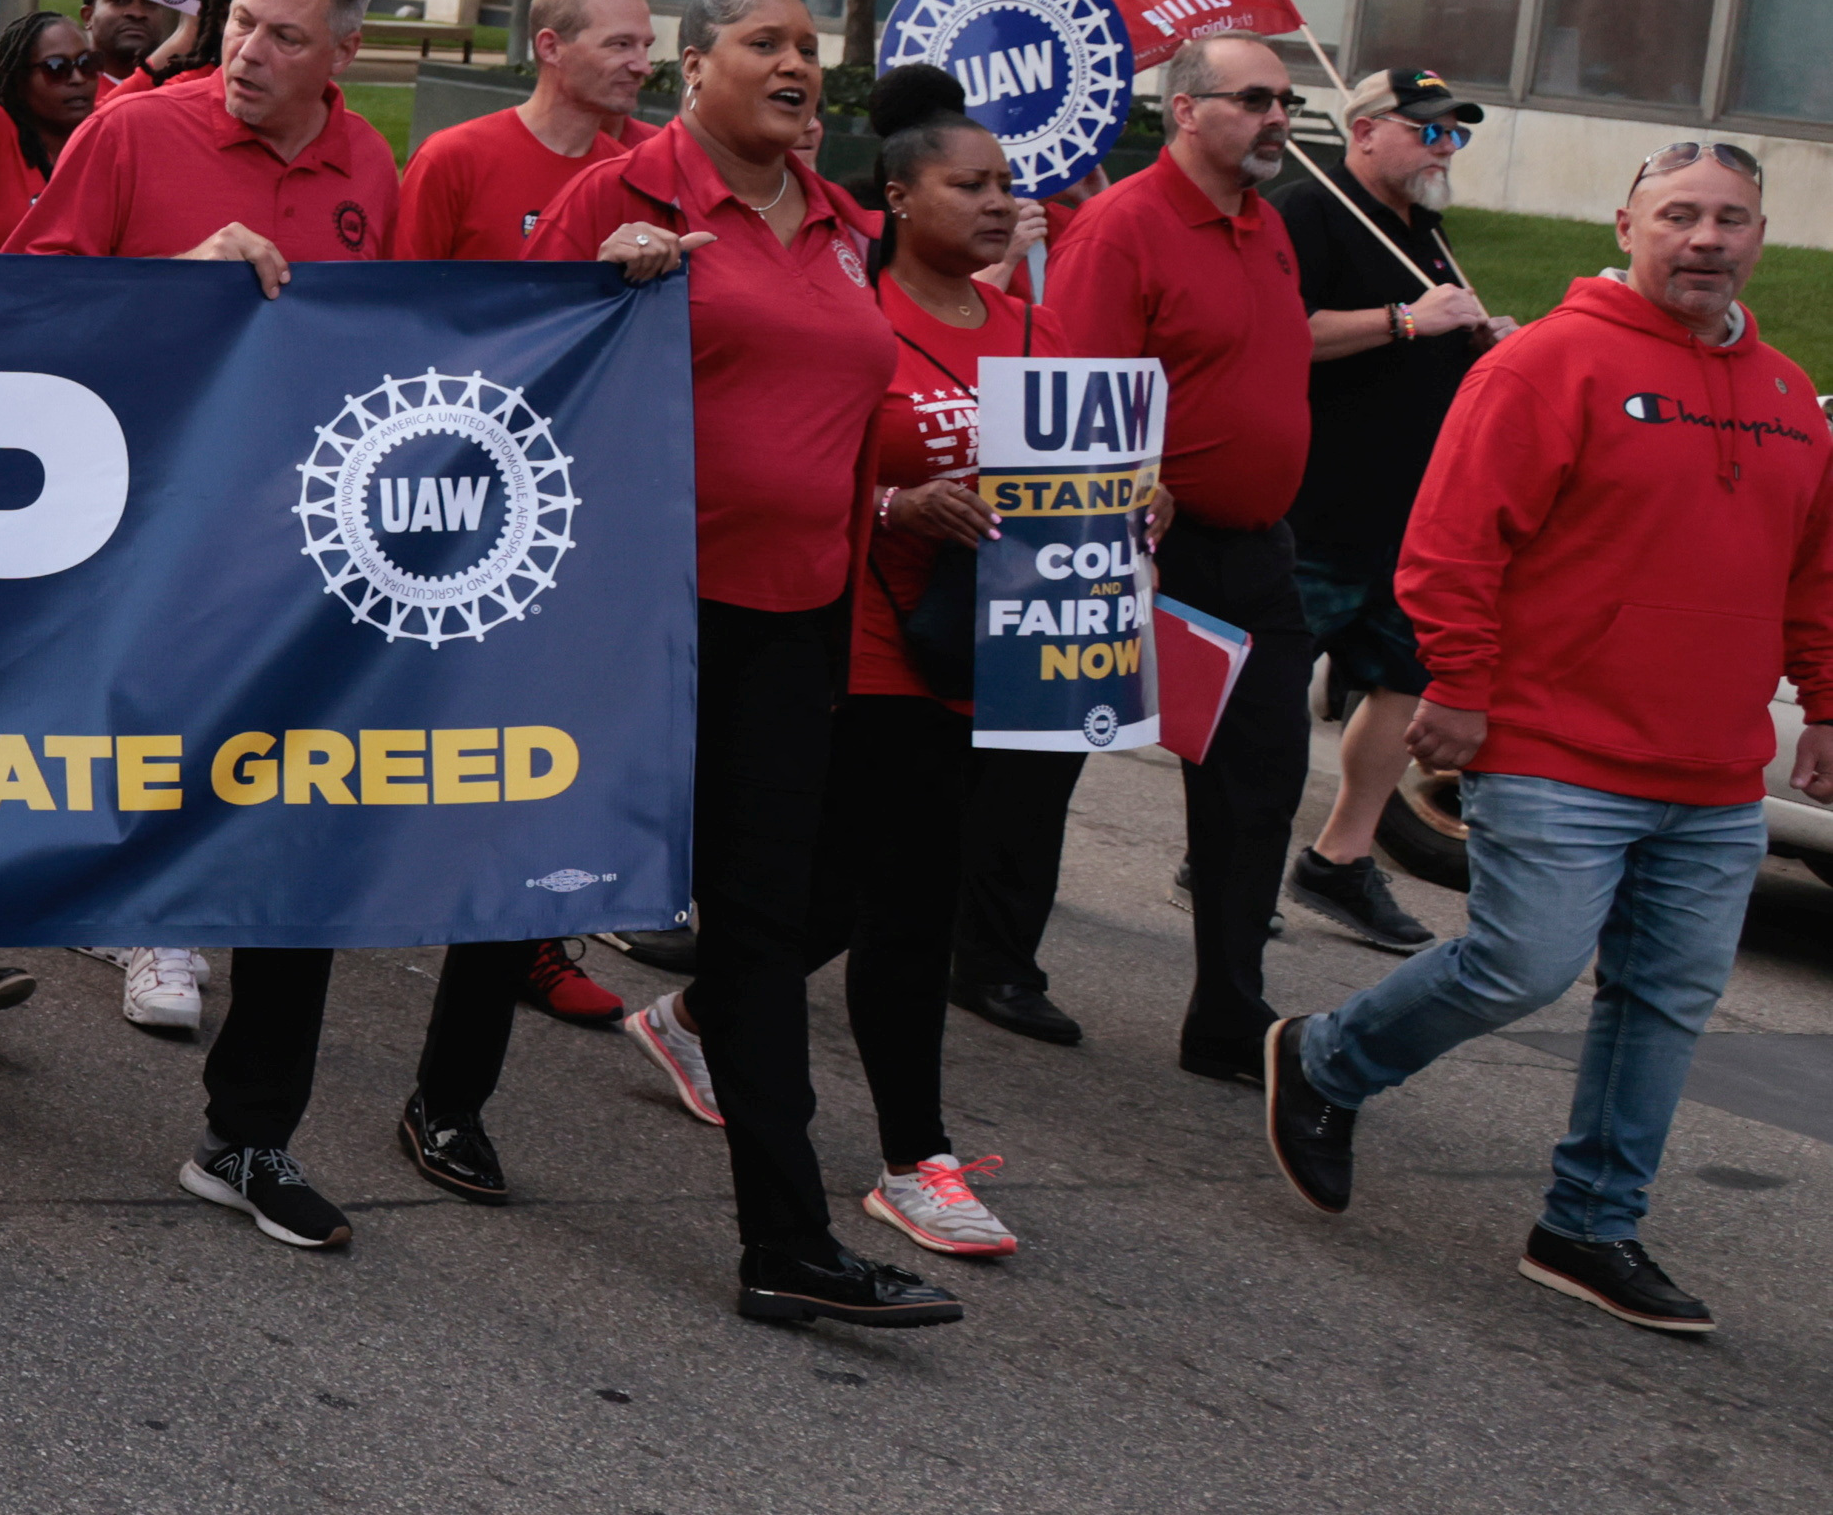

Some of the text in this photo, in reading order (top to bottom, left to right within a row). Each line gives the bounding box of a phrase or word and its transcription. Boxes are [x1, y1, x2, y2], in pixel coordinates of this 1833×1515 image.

[955, 40, 1052, 107] UAW
[1074, 37, 1087, 82] WORKERS
[1056, 101, 1081, 134] AMERICA
[1024, 371, 1155, 452] UAW
[1623, 392, 1813, 447] Champion
[341, 412, 529, 599] UNITED AUTOMOBILE, AEROSPACE AND AGRICULTURAL IMPLEMENT WORKERS OF AMERICA
[380, 476, 490, 534] UAW
[994, 478, 1133, 511] STAND
[1090, 582, 1122, 596] AND
[989, 596, 1109, 636] FAIR
[1040, 637, 1142, 681] NOW
[210, 724, 580, 807] GREED
[602, 873, 617, 882] 161
